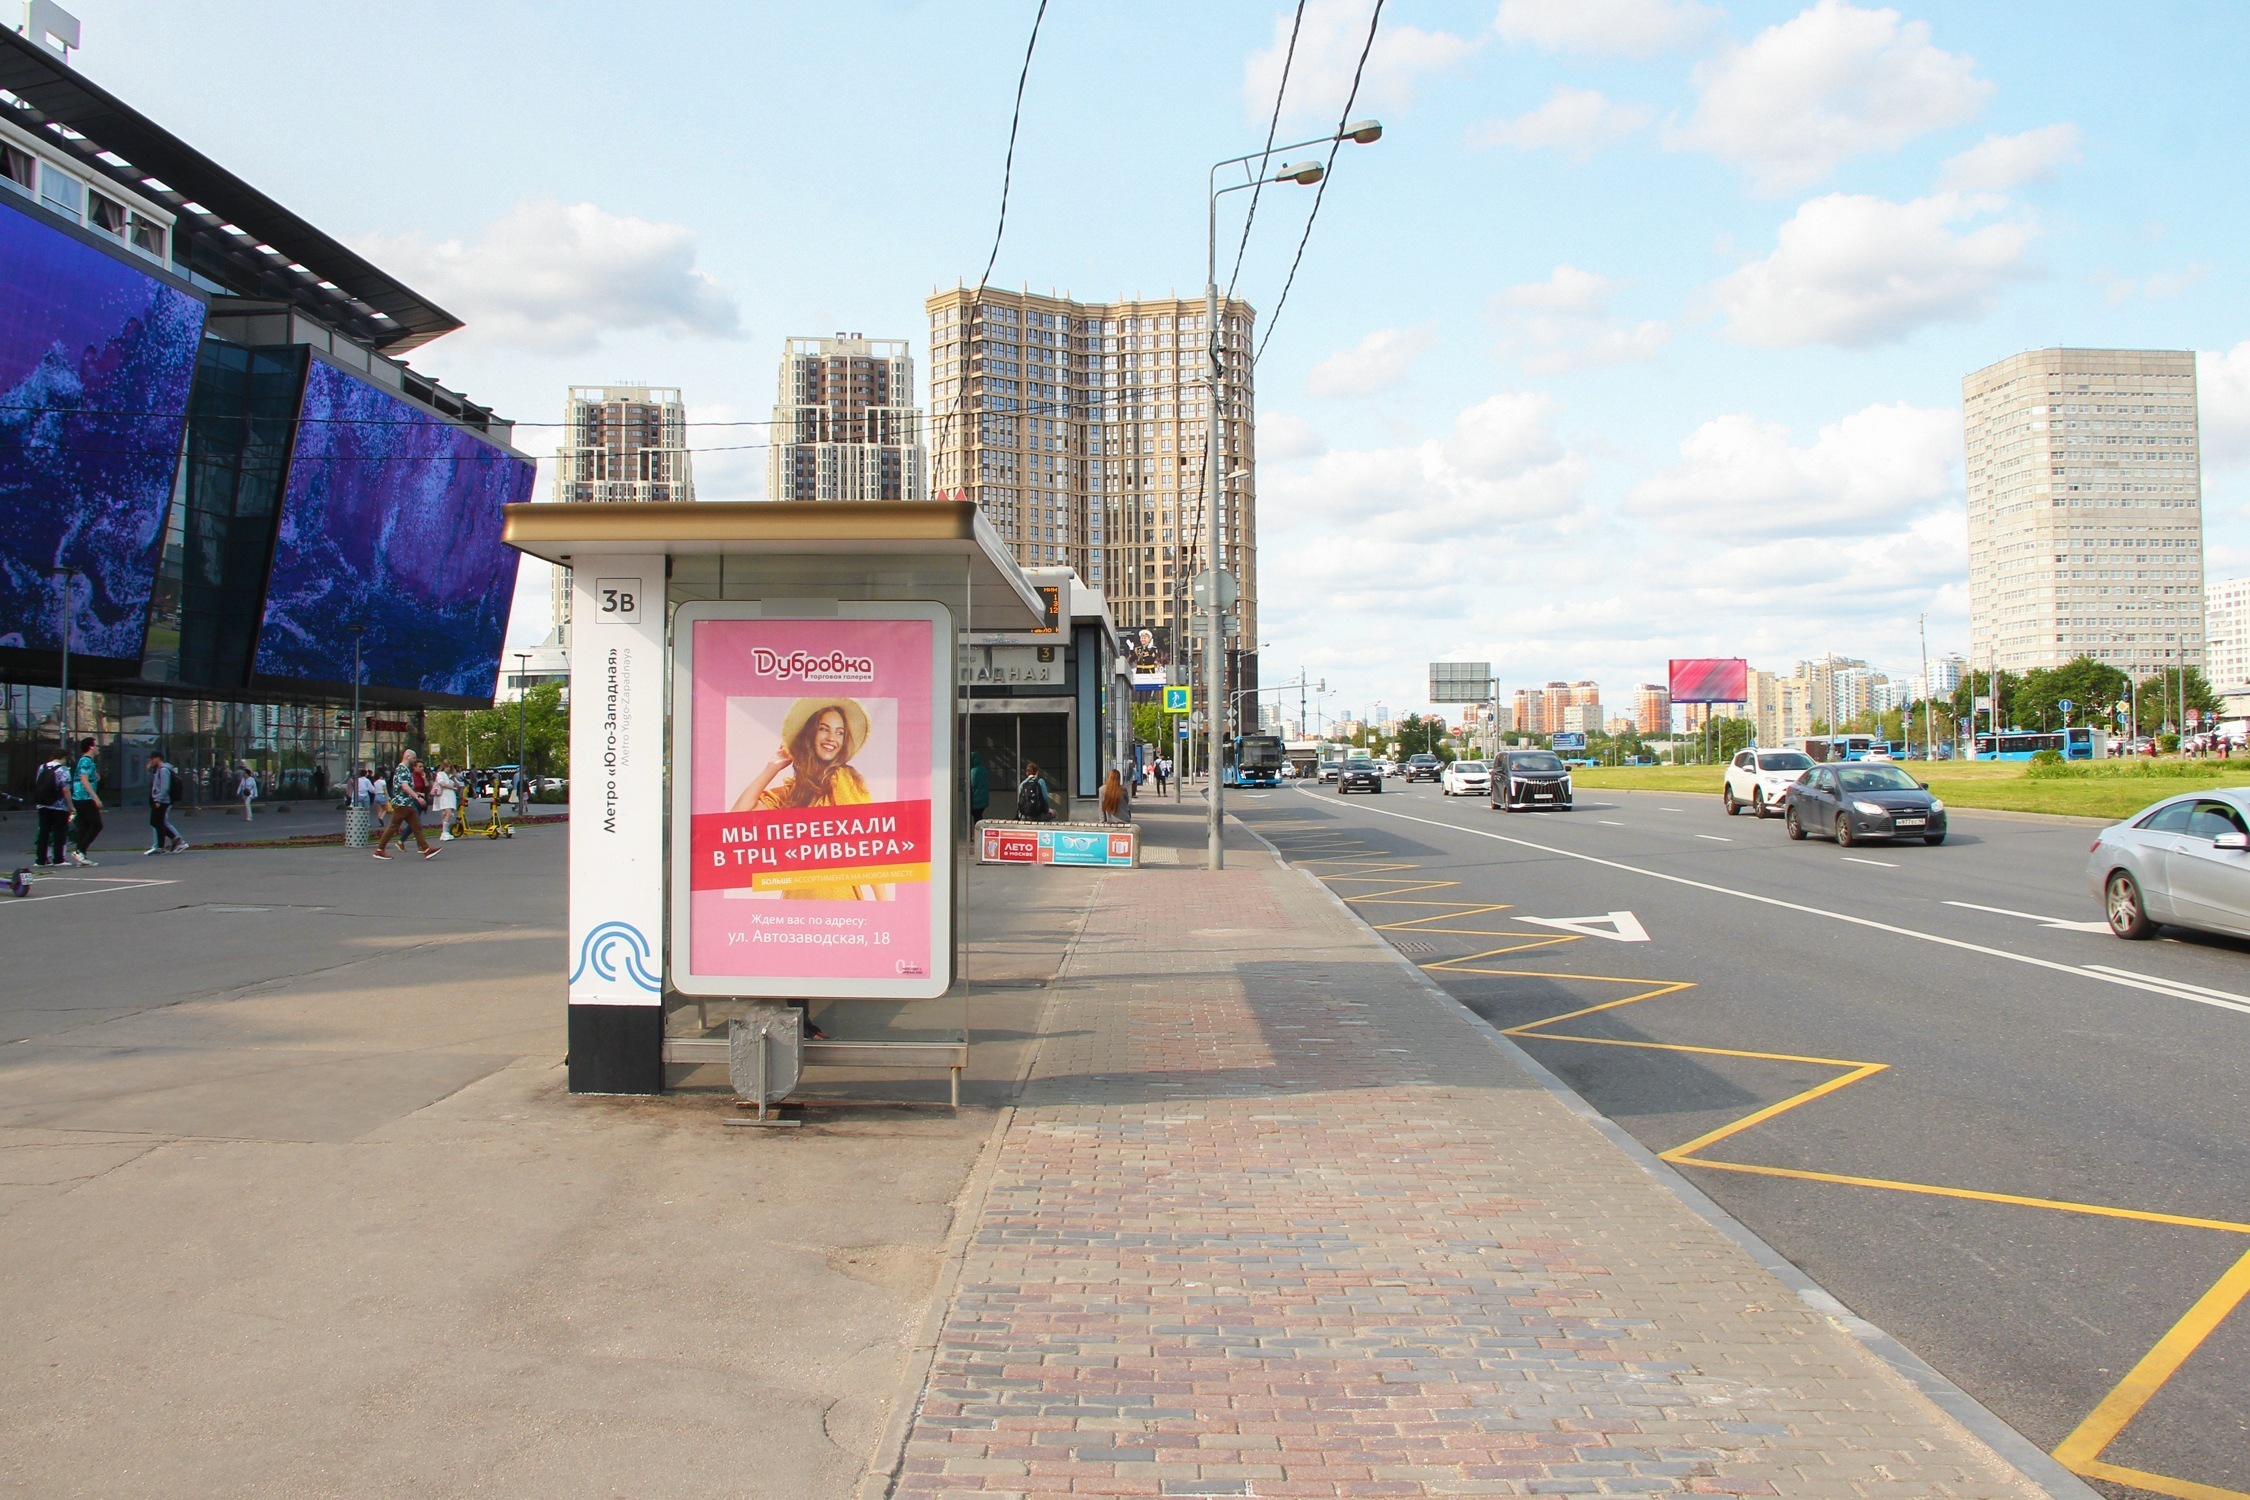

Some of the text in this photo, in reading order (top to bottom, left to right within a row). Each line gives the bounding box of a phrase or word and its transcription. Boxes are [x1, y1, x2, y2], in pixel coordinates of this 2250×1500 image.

[1042, 647, 1050, 658] 3
[753, 649, 872, 679] Дубровка
[621, 648, 632, 767] Metro Yugo-Zapadnaya
[603, 648, 618, 834] Метро «Юго-Западная»
[722, 816, 896, 843] МЫ ПЕРЕЕХАЛИ
[713, 838, 915, 867] В ТРЦ «РИВЬЕРА»
[1004, 843, 1033, 851] ЛЕТО
[761, 877, 793, 886] БОЛЬШЕ
[794, 873, 850, 883] АССОРТИМЕНТА
[862, 871, 889, 880] НОВОМ
[890, 869, 913, 878] МЕСТЕ
[751, 914, 867, 928] Ждем вас по адресу:
[727, 929, 890, 947] ул. Автозаводская, 18
